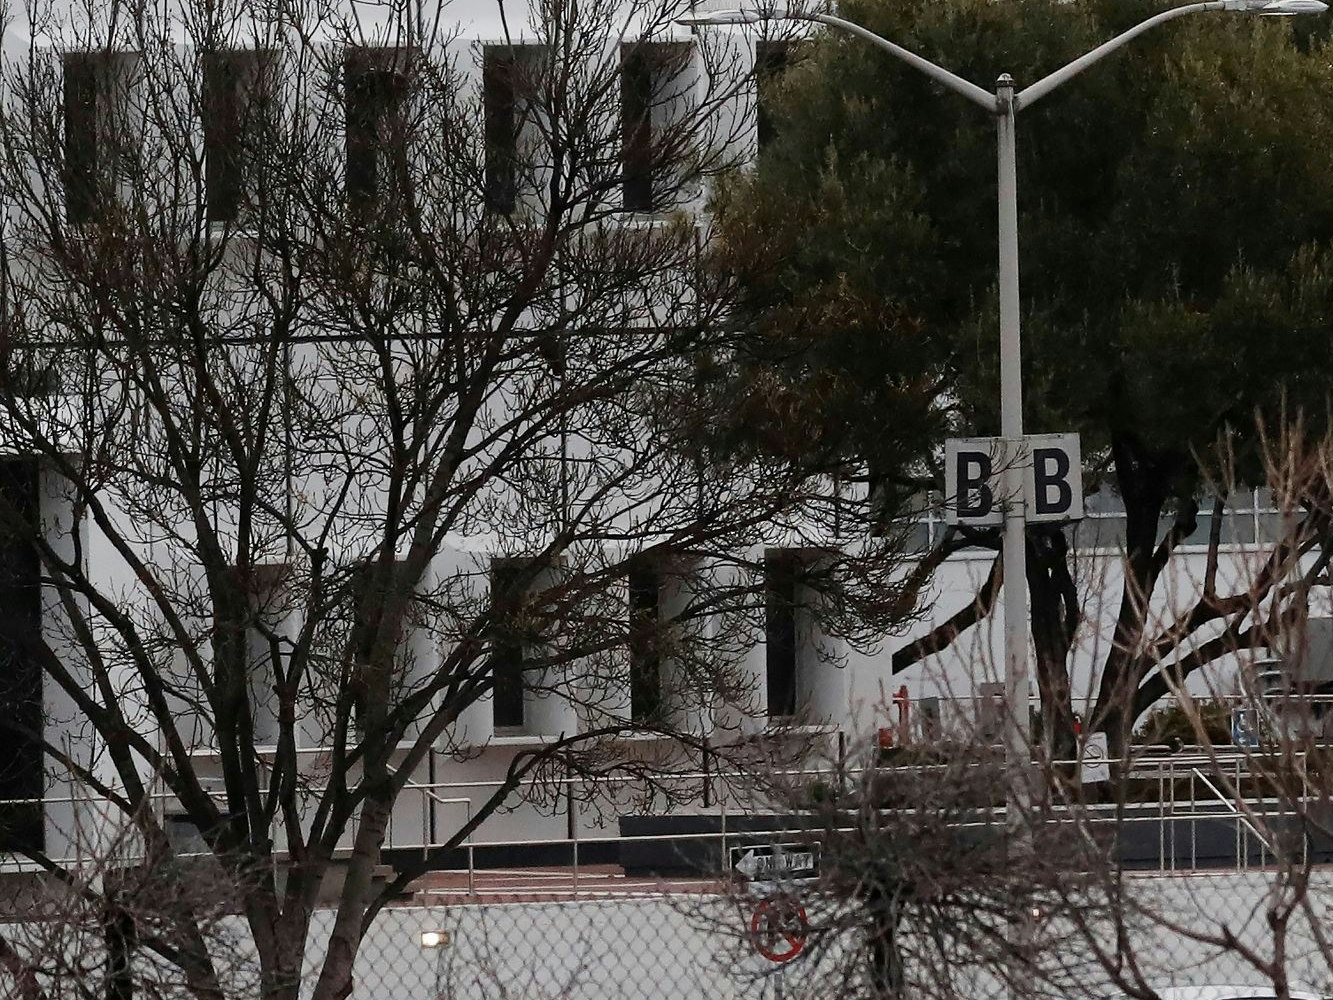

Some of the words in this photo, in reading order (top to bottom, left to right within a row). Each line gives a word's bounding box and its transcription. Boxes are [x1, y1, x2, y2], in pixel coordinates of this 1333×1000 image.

[956, 451, 993, 517] B
[1033, 448, 1072, 514] B
[756, 856, 780, 872] ON
